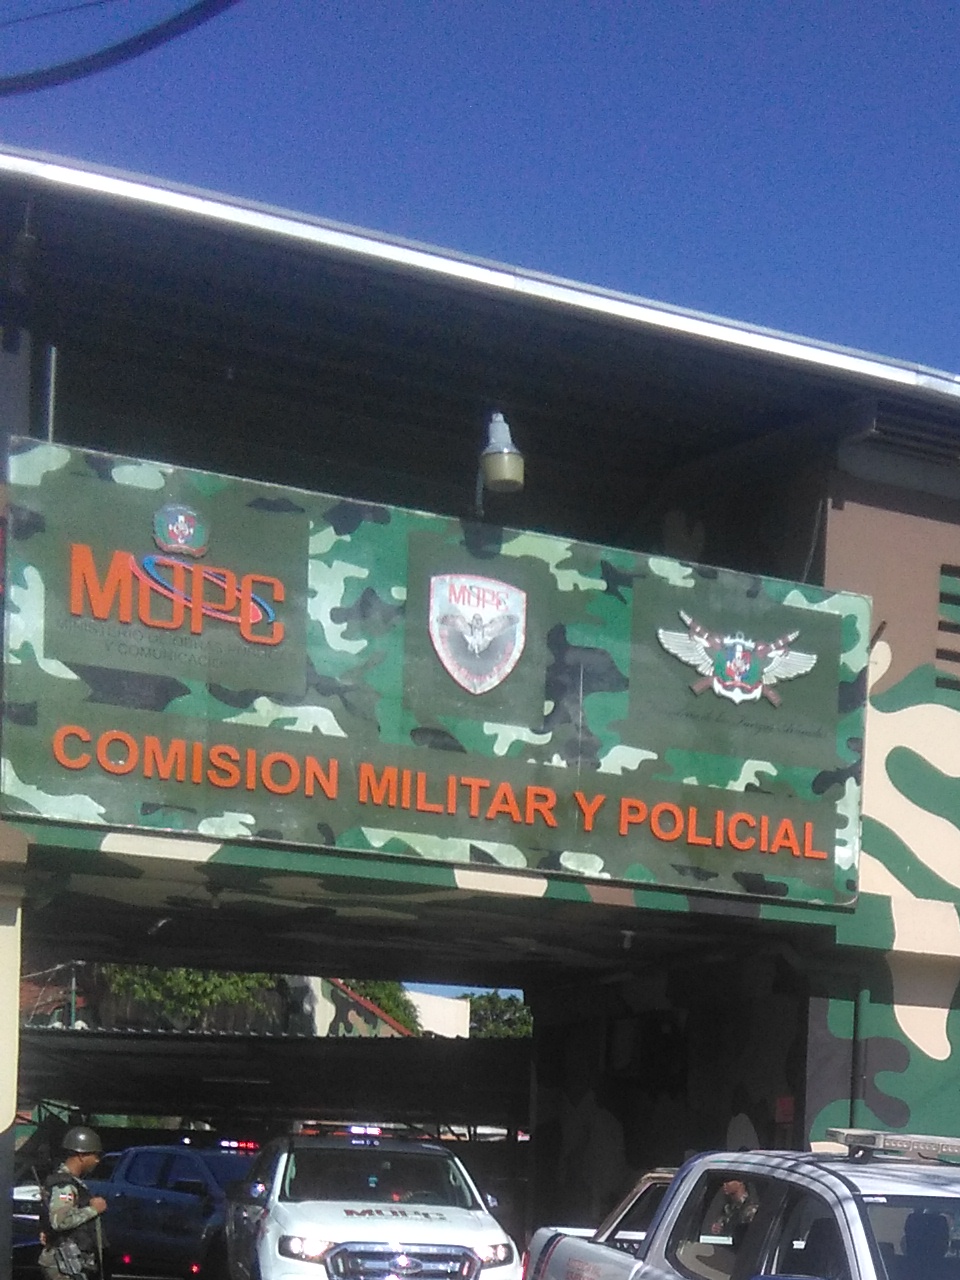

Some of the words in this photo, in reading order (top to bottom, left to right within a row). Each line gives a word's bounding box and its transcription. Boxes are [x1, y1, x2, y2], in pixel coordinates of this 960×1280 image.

[70, 543, 284, 646] MOPC
[52, 724, 339, 800] COMISION
[358, 762, 558, 828] MILITAR
[574, 791, 606, 832] Y
[619, 797, 829, 860] POLICIAL
